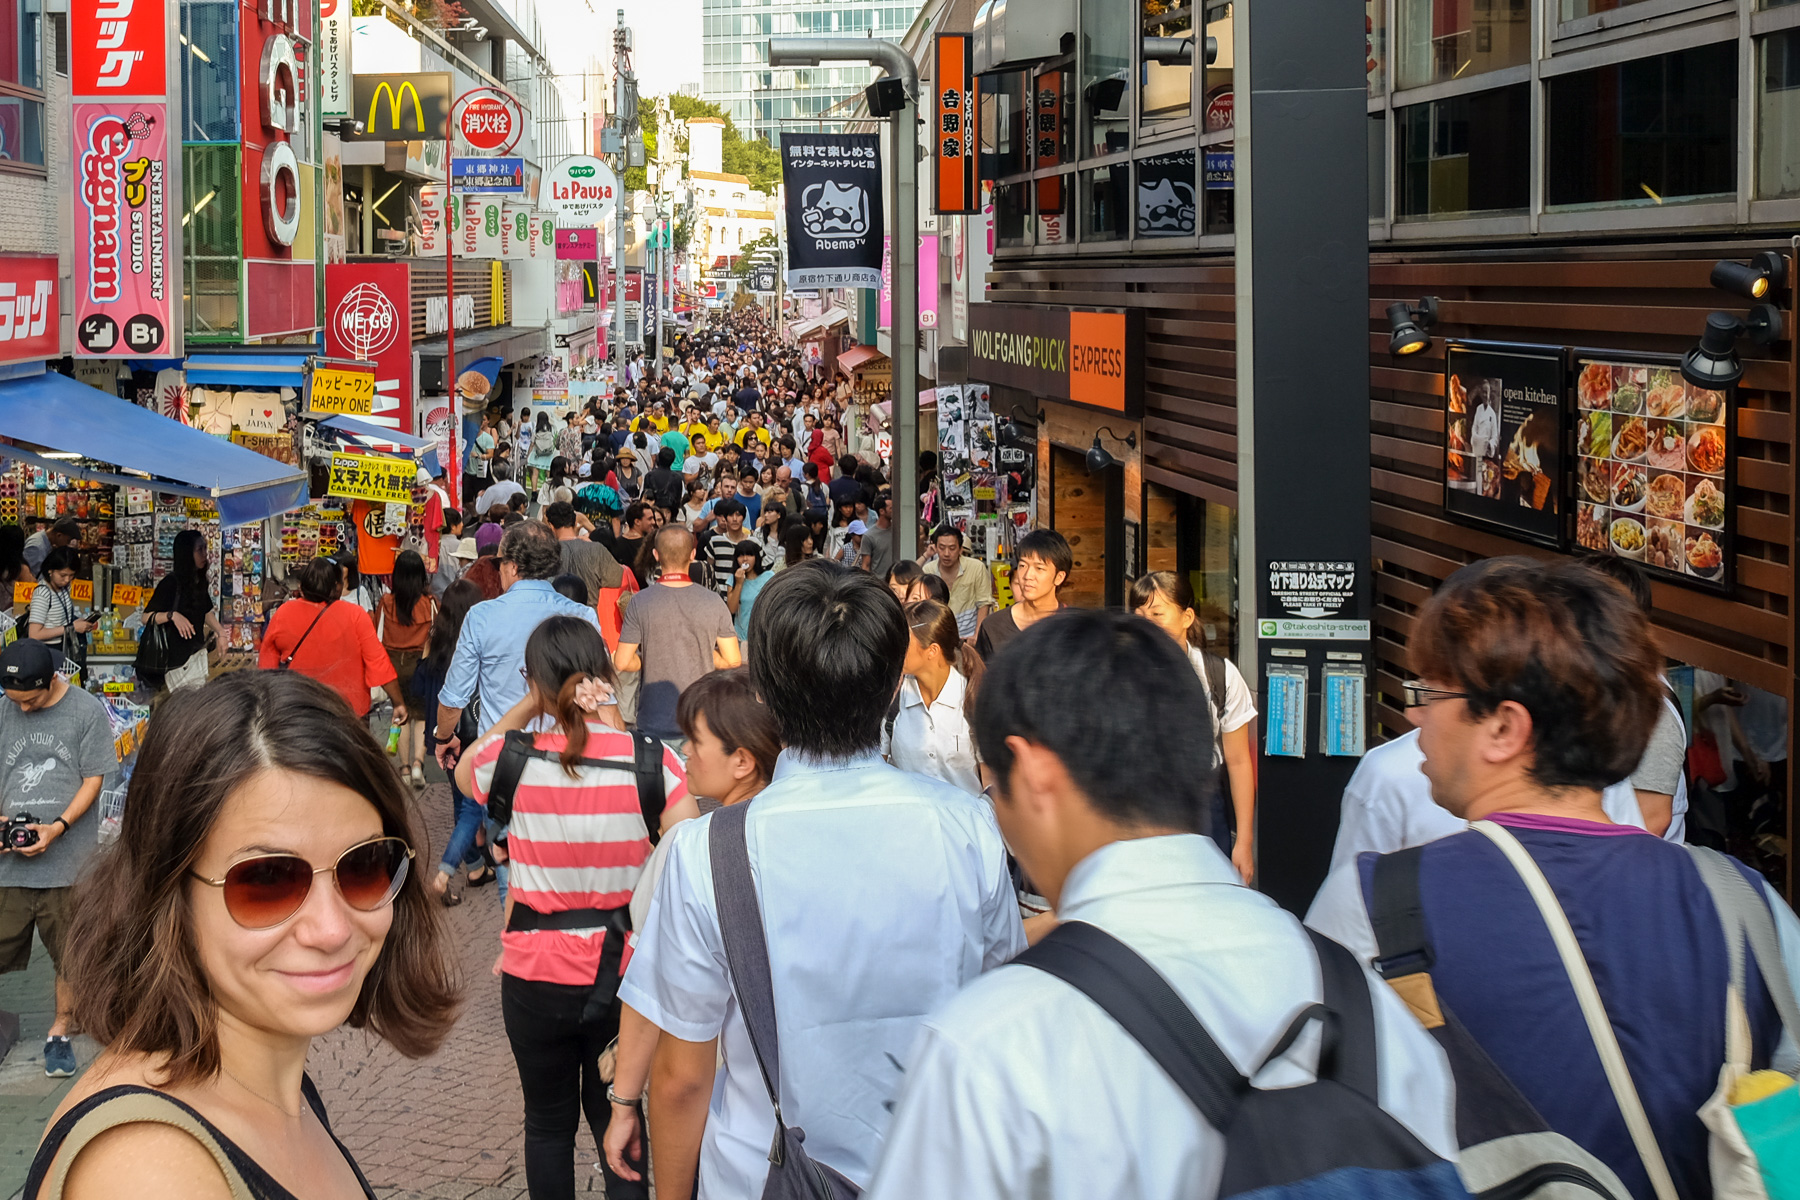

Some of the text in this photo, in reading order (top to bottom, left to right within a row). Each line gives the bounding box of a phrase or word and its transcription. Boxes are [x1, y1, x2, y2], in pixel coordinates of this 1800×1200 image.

[465, 113, 508, 134] 消火栓
[942, 88, 961, 158] 吉野家
[964, 90, 973, 156] YOSHINOYA
[789, 145, 875, 158] 無料で楽しめる
[465, 164, 509, 174] 東郷神社
[790, 160, 876, 169] インターネットテレビ局
[465, 176, 512, 187] 東郷記念館
[553, 180, 612, 201] La Pausa
[124, 157, 150, 273] プリ STUDIO
[465, 201, 481, 216] La
[151, 160, 163, 300] ENTERTAINMENT
[924, 220, 935, 228] 1F
[464, 217, 481, 253] Pausa
[799, 273, 877, 285] 原宿竹下通り商店会
[922, 314, 934, 322] B1
[131, 322, 158, 345] B1
[972, 329, 1122, 378] WOLFGANG PUCK EXPRESS
[80, 367, 110, 376] TOKYO
[314, 375, 372, 393] ハッピーワン
[312, 394, 370, 413] HAPPY ONE
[1503, 386, 1557, 405] open kitchen
[246, 419, 274, 429] JAPAN
[240, 434, 281, 447] T-SHIRT
[332, 467, 411, 492] 文字入れ無料
[331, 484, 368, 495] CARVING
[386, 491, 408, 500] FREE
[366, 512, 385, 535] 悟
[1269, 571, 1355, 590] 竹下通り公式マップ
[1282, 621, 1368, 631] @takeshita-street
[5, 732, 72, 766] ENJOY YOUR TRIP
